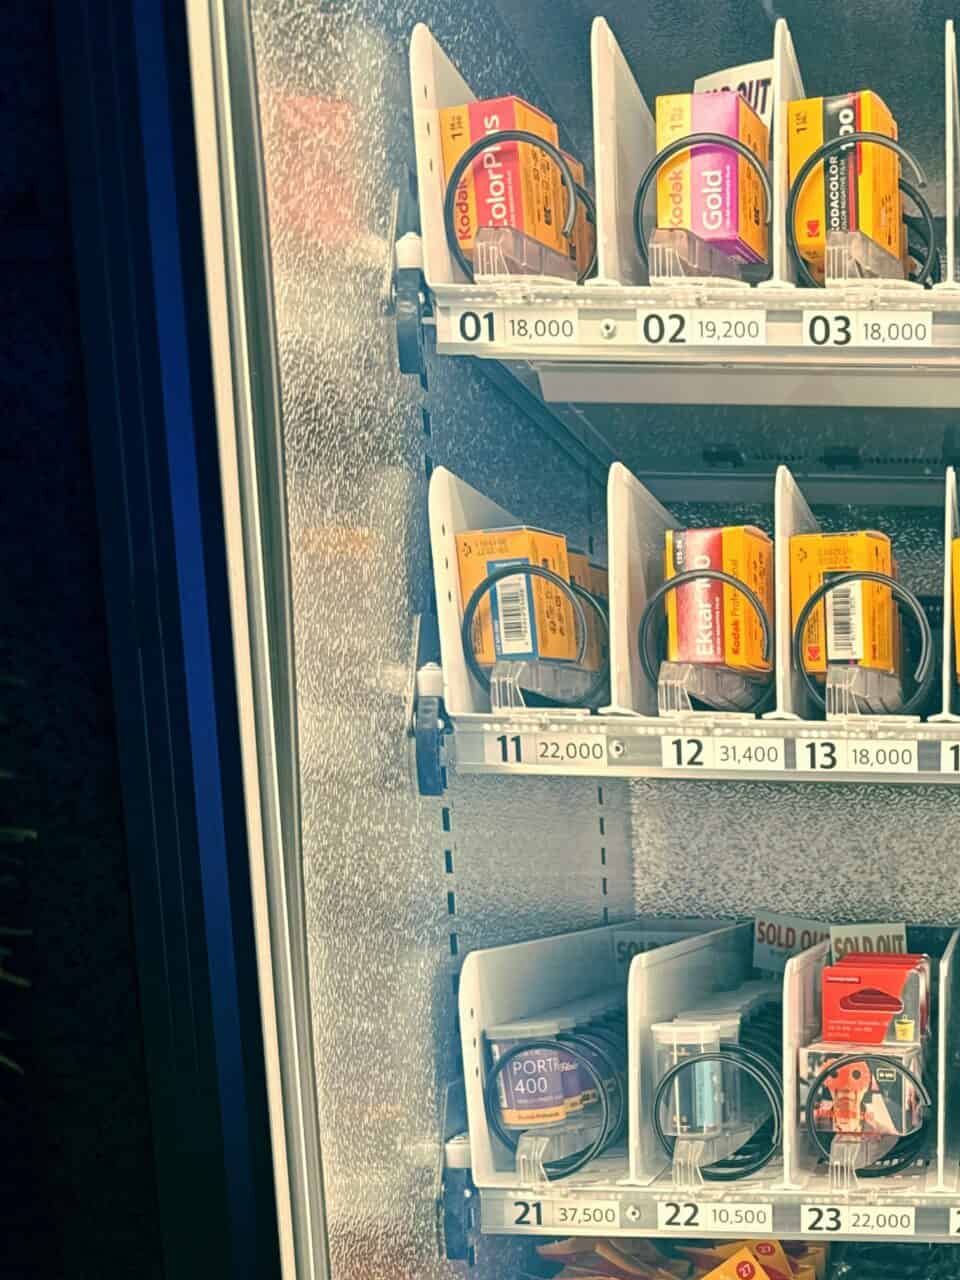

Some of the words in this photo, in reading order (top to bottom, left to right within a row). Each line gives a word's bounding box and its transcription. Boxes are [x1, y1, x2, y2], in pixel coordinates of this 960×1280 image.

[702, 169, 723, 231] Gold
[829, 156, 841, 232] ODACOLOR
[459, 312, 496, 341] 01
[509, 319, 574, 338] 18,000
[643, 314, 686, 344] 02
[698, 321, 760, 340] 19,200
[808, 315, 851, 345] 03
[863, 322, 927, 343] 18,000
[695, 602, 713, 656] Ektar
[497, 736, 522, 763] 11
[538, 742, 604, 761] 22,000
[672, 739, 704, 767] 12
[719, 745, 779, 764] 31,400
[805, 742, 837, 770] 13
[852, 748, 913, 767] 18,000
[757, 922, 796, 949] SOLD
[514, 1077, 549, 1095] 400
[513, 1202, 544, 1226] 21
[558, 1208, 616, 1225] 37,500
[664, 1203, 700, 1227] 22
[711, 1208, 768, 1227] 10,500
[807, 1208, 842, 1232] 23
[851, 1214, 911, 1231] 22,000
